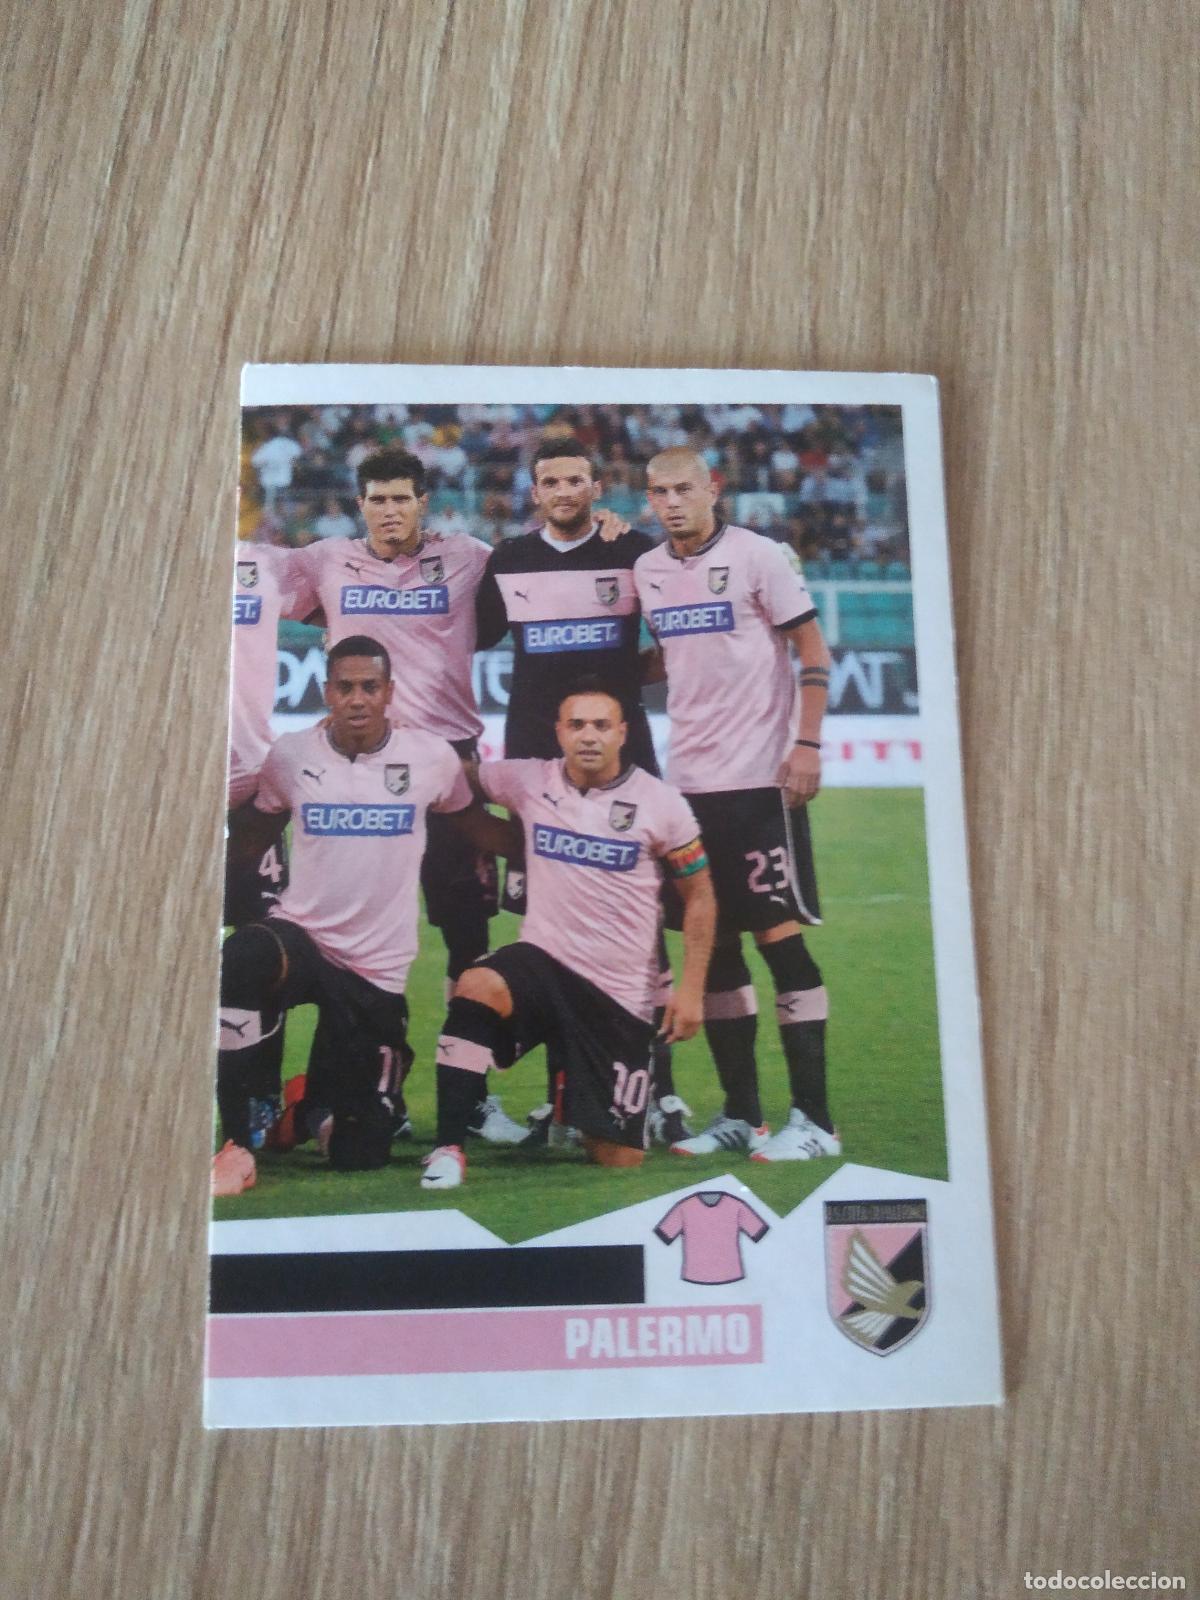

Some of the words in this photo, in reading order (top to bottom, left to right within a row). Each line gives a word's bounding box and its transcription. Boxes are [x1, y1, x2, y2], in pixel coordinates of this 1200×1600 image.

[744, 846, 789, 893] 23
[612, 1061, 649, 1114] 10
[564, 1312, 750, 1360] PALERMO
